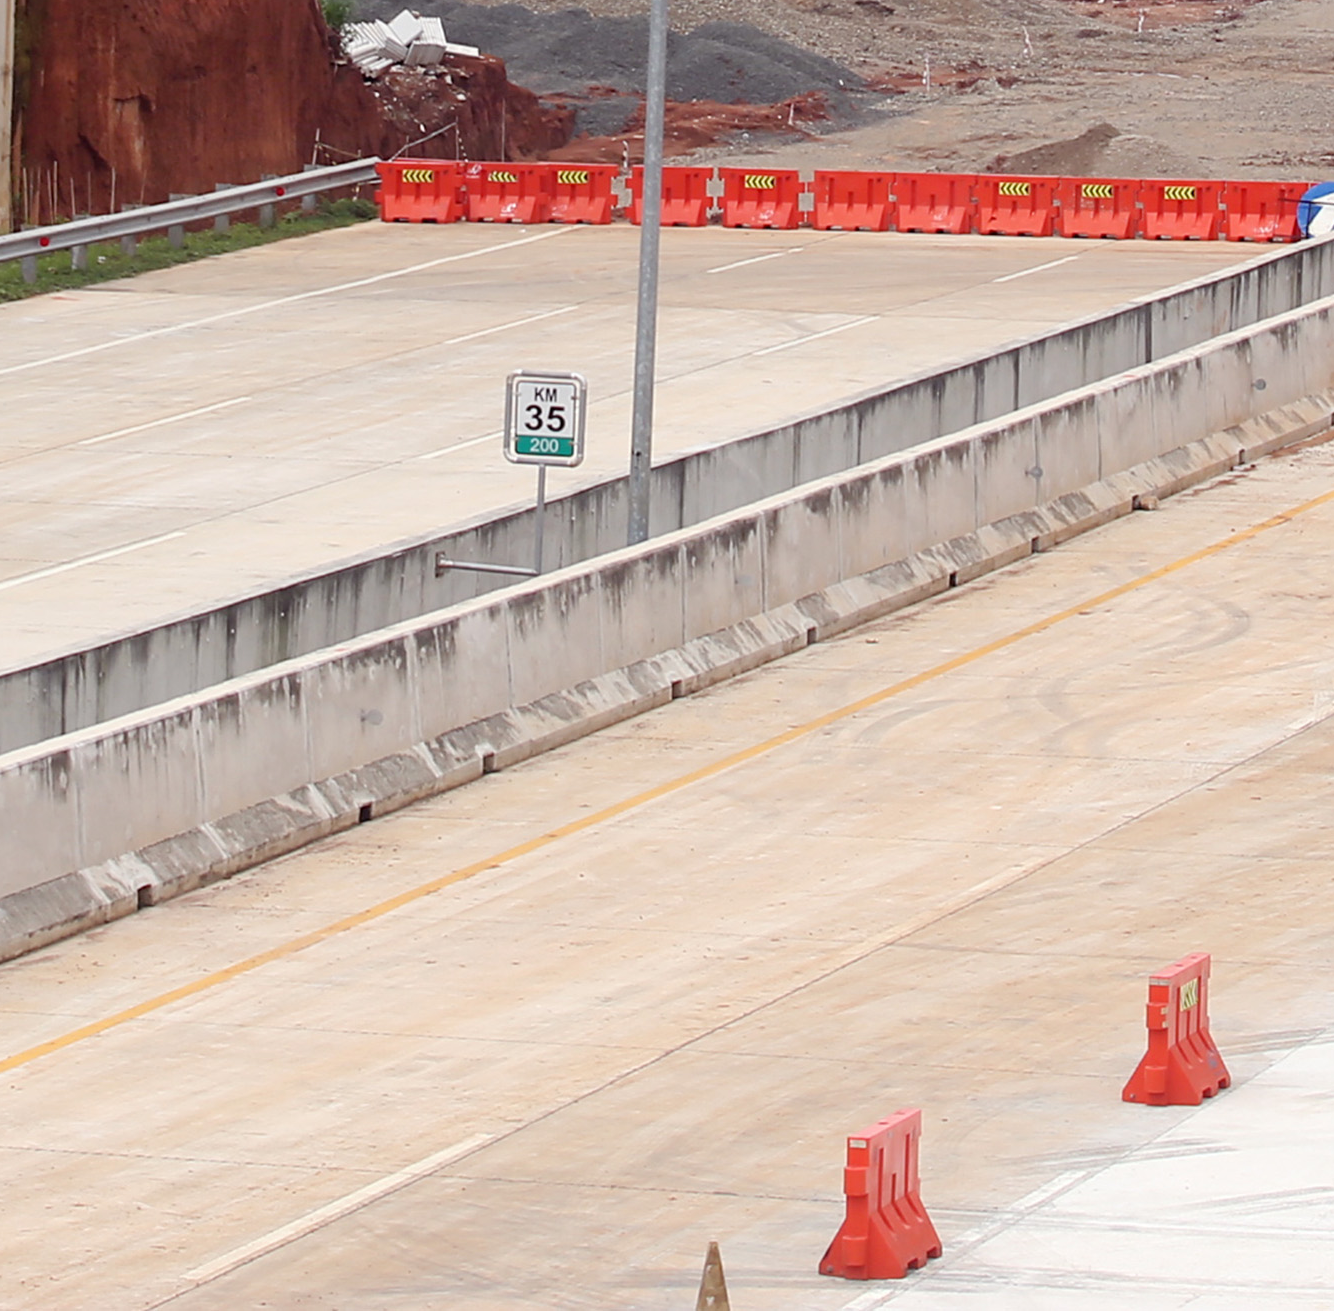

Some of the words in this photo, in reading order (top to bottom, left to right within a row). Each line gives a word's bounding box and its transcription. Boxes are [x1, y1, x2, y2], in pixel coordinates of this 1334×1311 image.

[534, 387, 557, 402] KM
[524, 404, 565, 432] 35
[530, 438, 559, 453] 200
